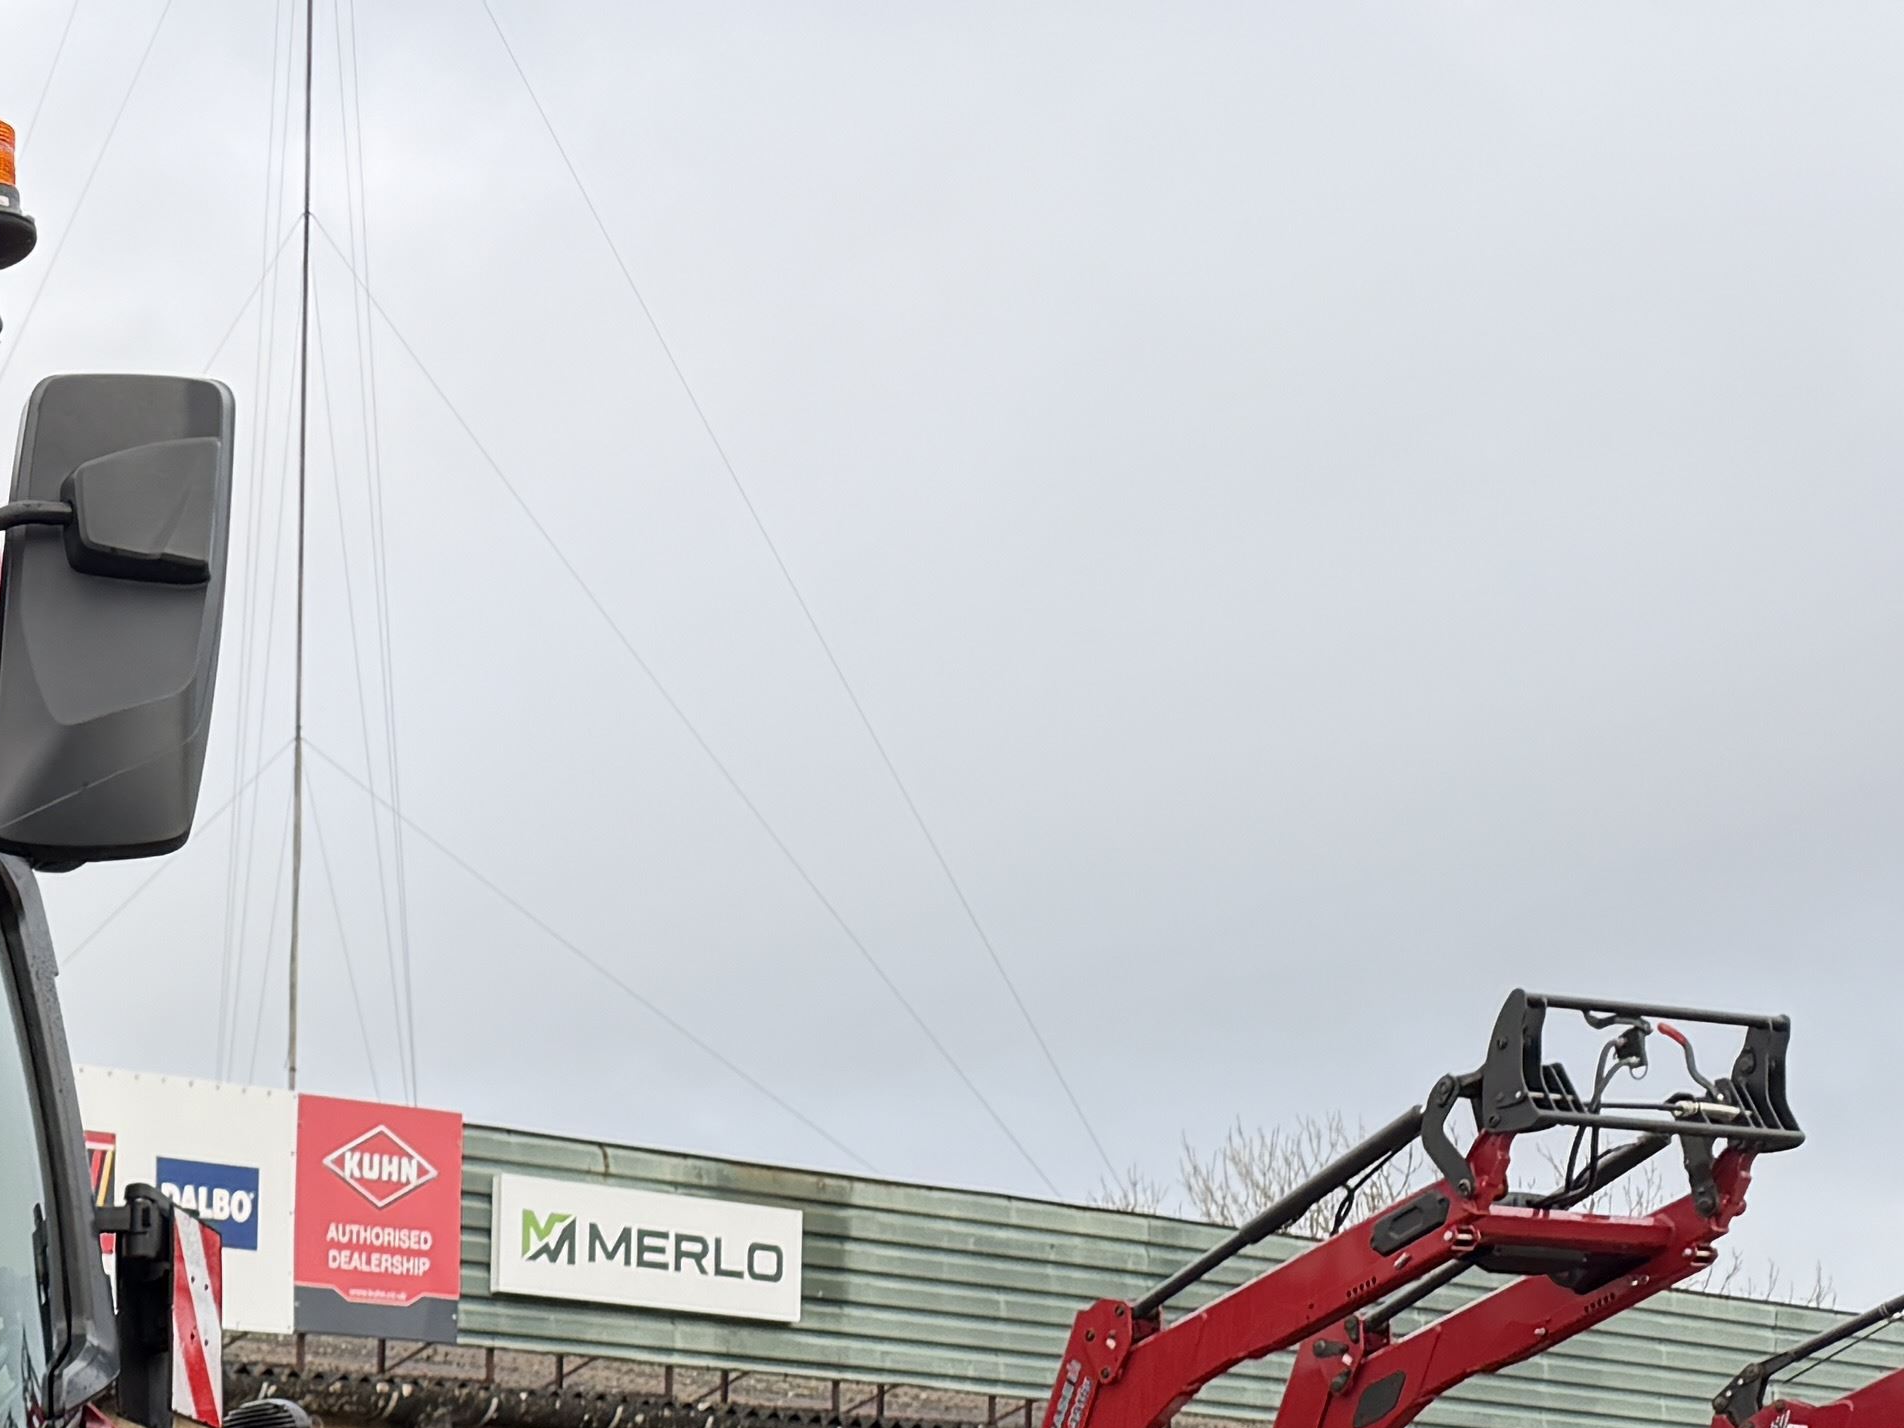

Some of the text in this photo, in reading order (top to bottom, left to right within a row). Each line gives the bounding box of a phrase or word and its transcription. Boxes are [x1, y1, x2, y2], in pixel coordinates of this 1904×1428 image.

[344, 1151, 418, 1185] KUHN
[326, 1222, 433, 1251] AUTHORISED
[328, 1248, 431, 1277] DEALERSHIP
[588, 1222, 784, 1283] MERLO
